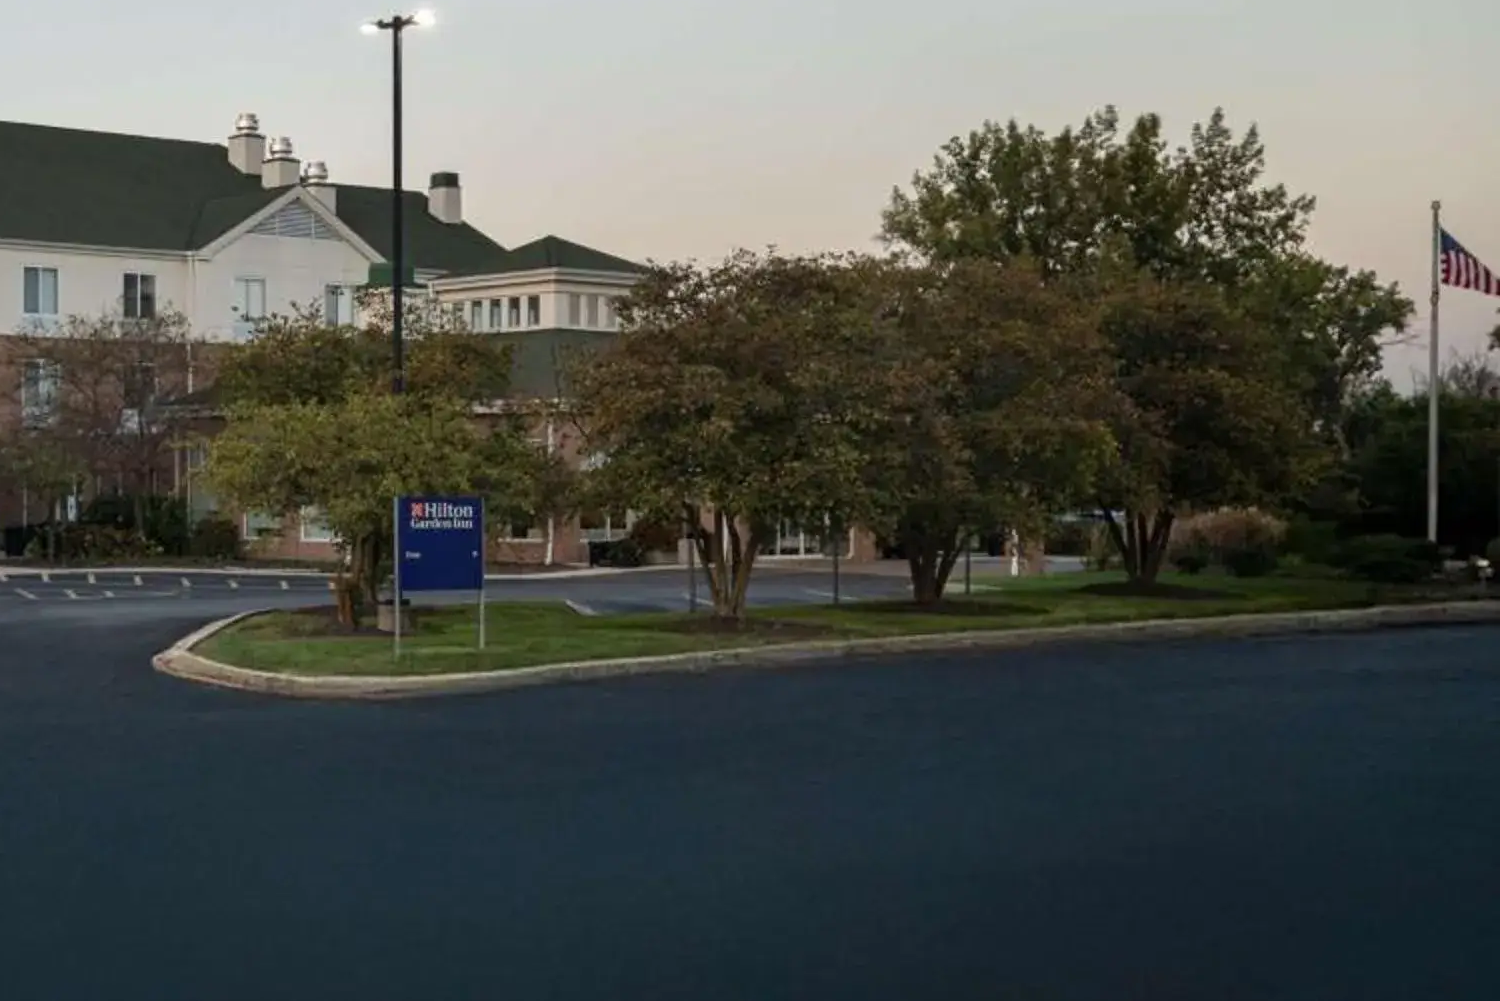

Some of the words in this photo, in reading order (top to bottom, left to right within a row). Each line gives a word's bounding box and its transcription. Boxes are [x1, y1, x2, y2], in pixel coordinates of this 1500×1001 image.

[425, 502, 473, 518] Hilton
[410, 517, 452, 529] Garden
[453, 517, 473, 529] Inn
